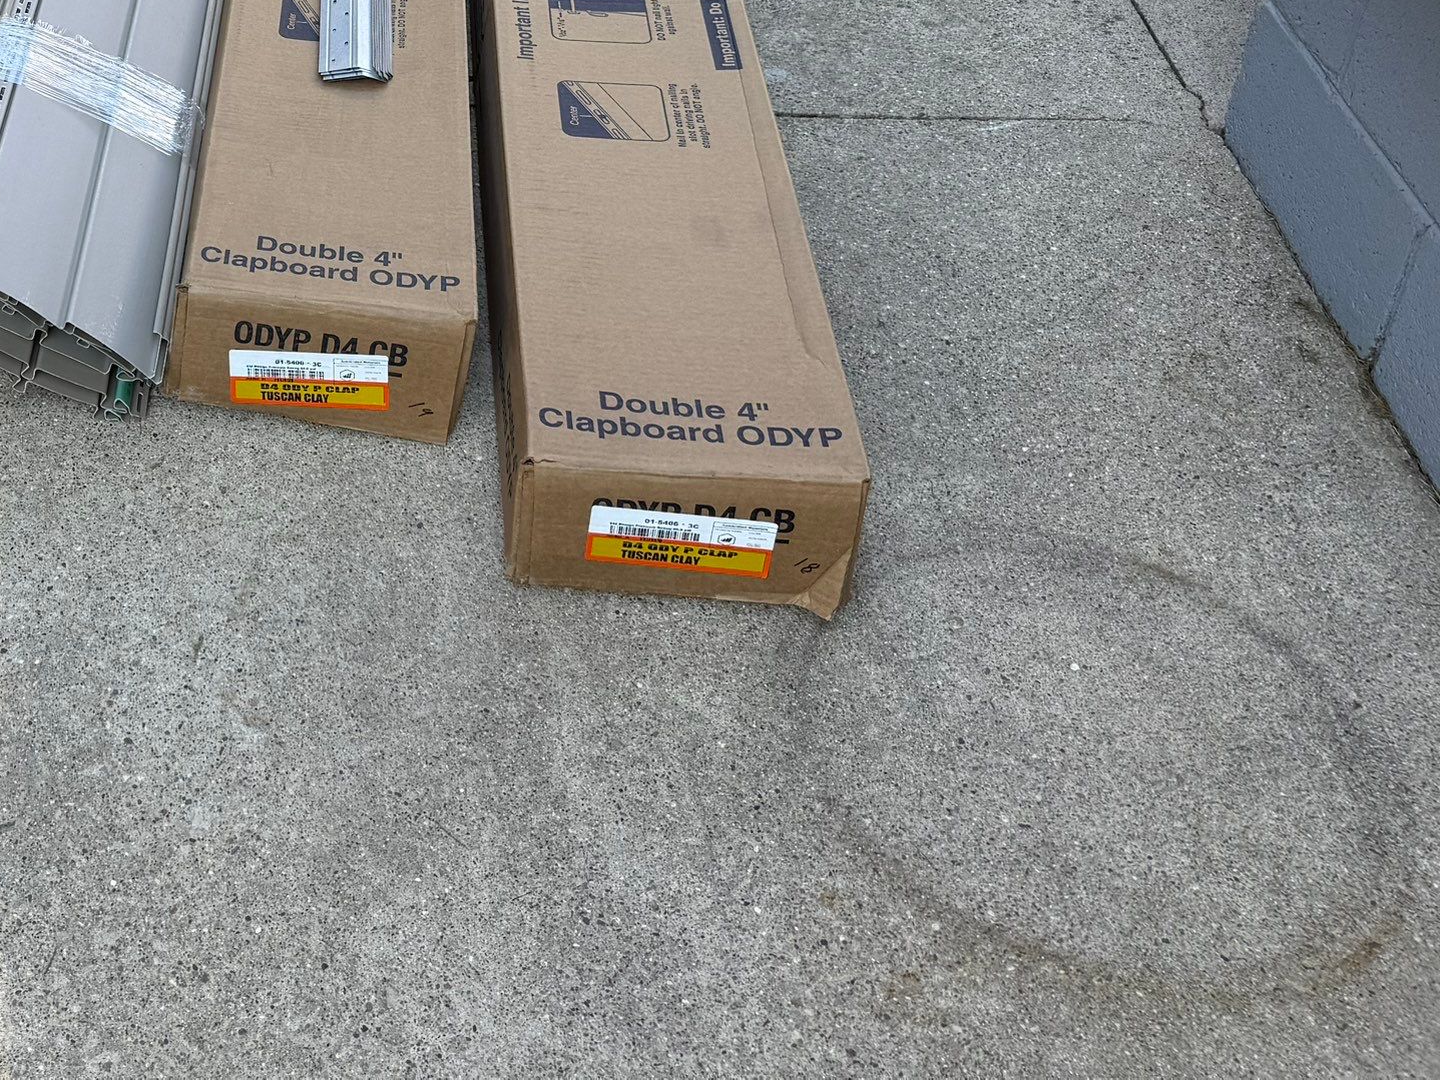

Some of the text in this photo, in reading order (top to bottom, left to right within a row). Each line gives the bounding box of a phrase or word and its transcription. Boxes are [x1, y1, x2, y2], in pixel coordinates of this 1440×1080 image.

[397, 9, 405, 19] NOT
[652, 11, 661, 20] nail
[709, 2, 722, 15] Do
[514, 7, 537, 60] Important
[654, 21, 664, 32] NOT
[712, 17, 735, 66] Important:
[668, 84, 678, 101] nailing
[680, 95, 691, 109] nails
[569, 105, 580, 126] Center
[673, 110, 683, 127] center
[685, 110, 696, 129] driving
[690, 83, 710, 148] straight. DO NOT angle.
[676, 135, 687, 147] Nail
[688, 131, 697, 141] slot
[256, 235, 403, 267] Double 4"
[200, 246, 461, 292] Clapboard ODYP
[233, 320, 408, 368] ODYP D4 CB
[261, 391, 330, 404] TUSCAN CLAY
[282, 384, 310, 392] ODY
[325, 386, 360, 394] CLAP
[598, 390, 769, 422] Double 4"
[538, 407, 843, 448] Clapboard ODYP
[621, 549, 701, 566] TUSCAN CLAY
[622, 541, 738, 558] D4 ODY P CLAP
